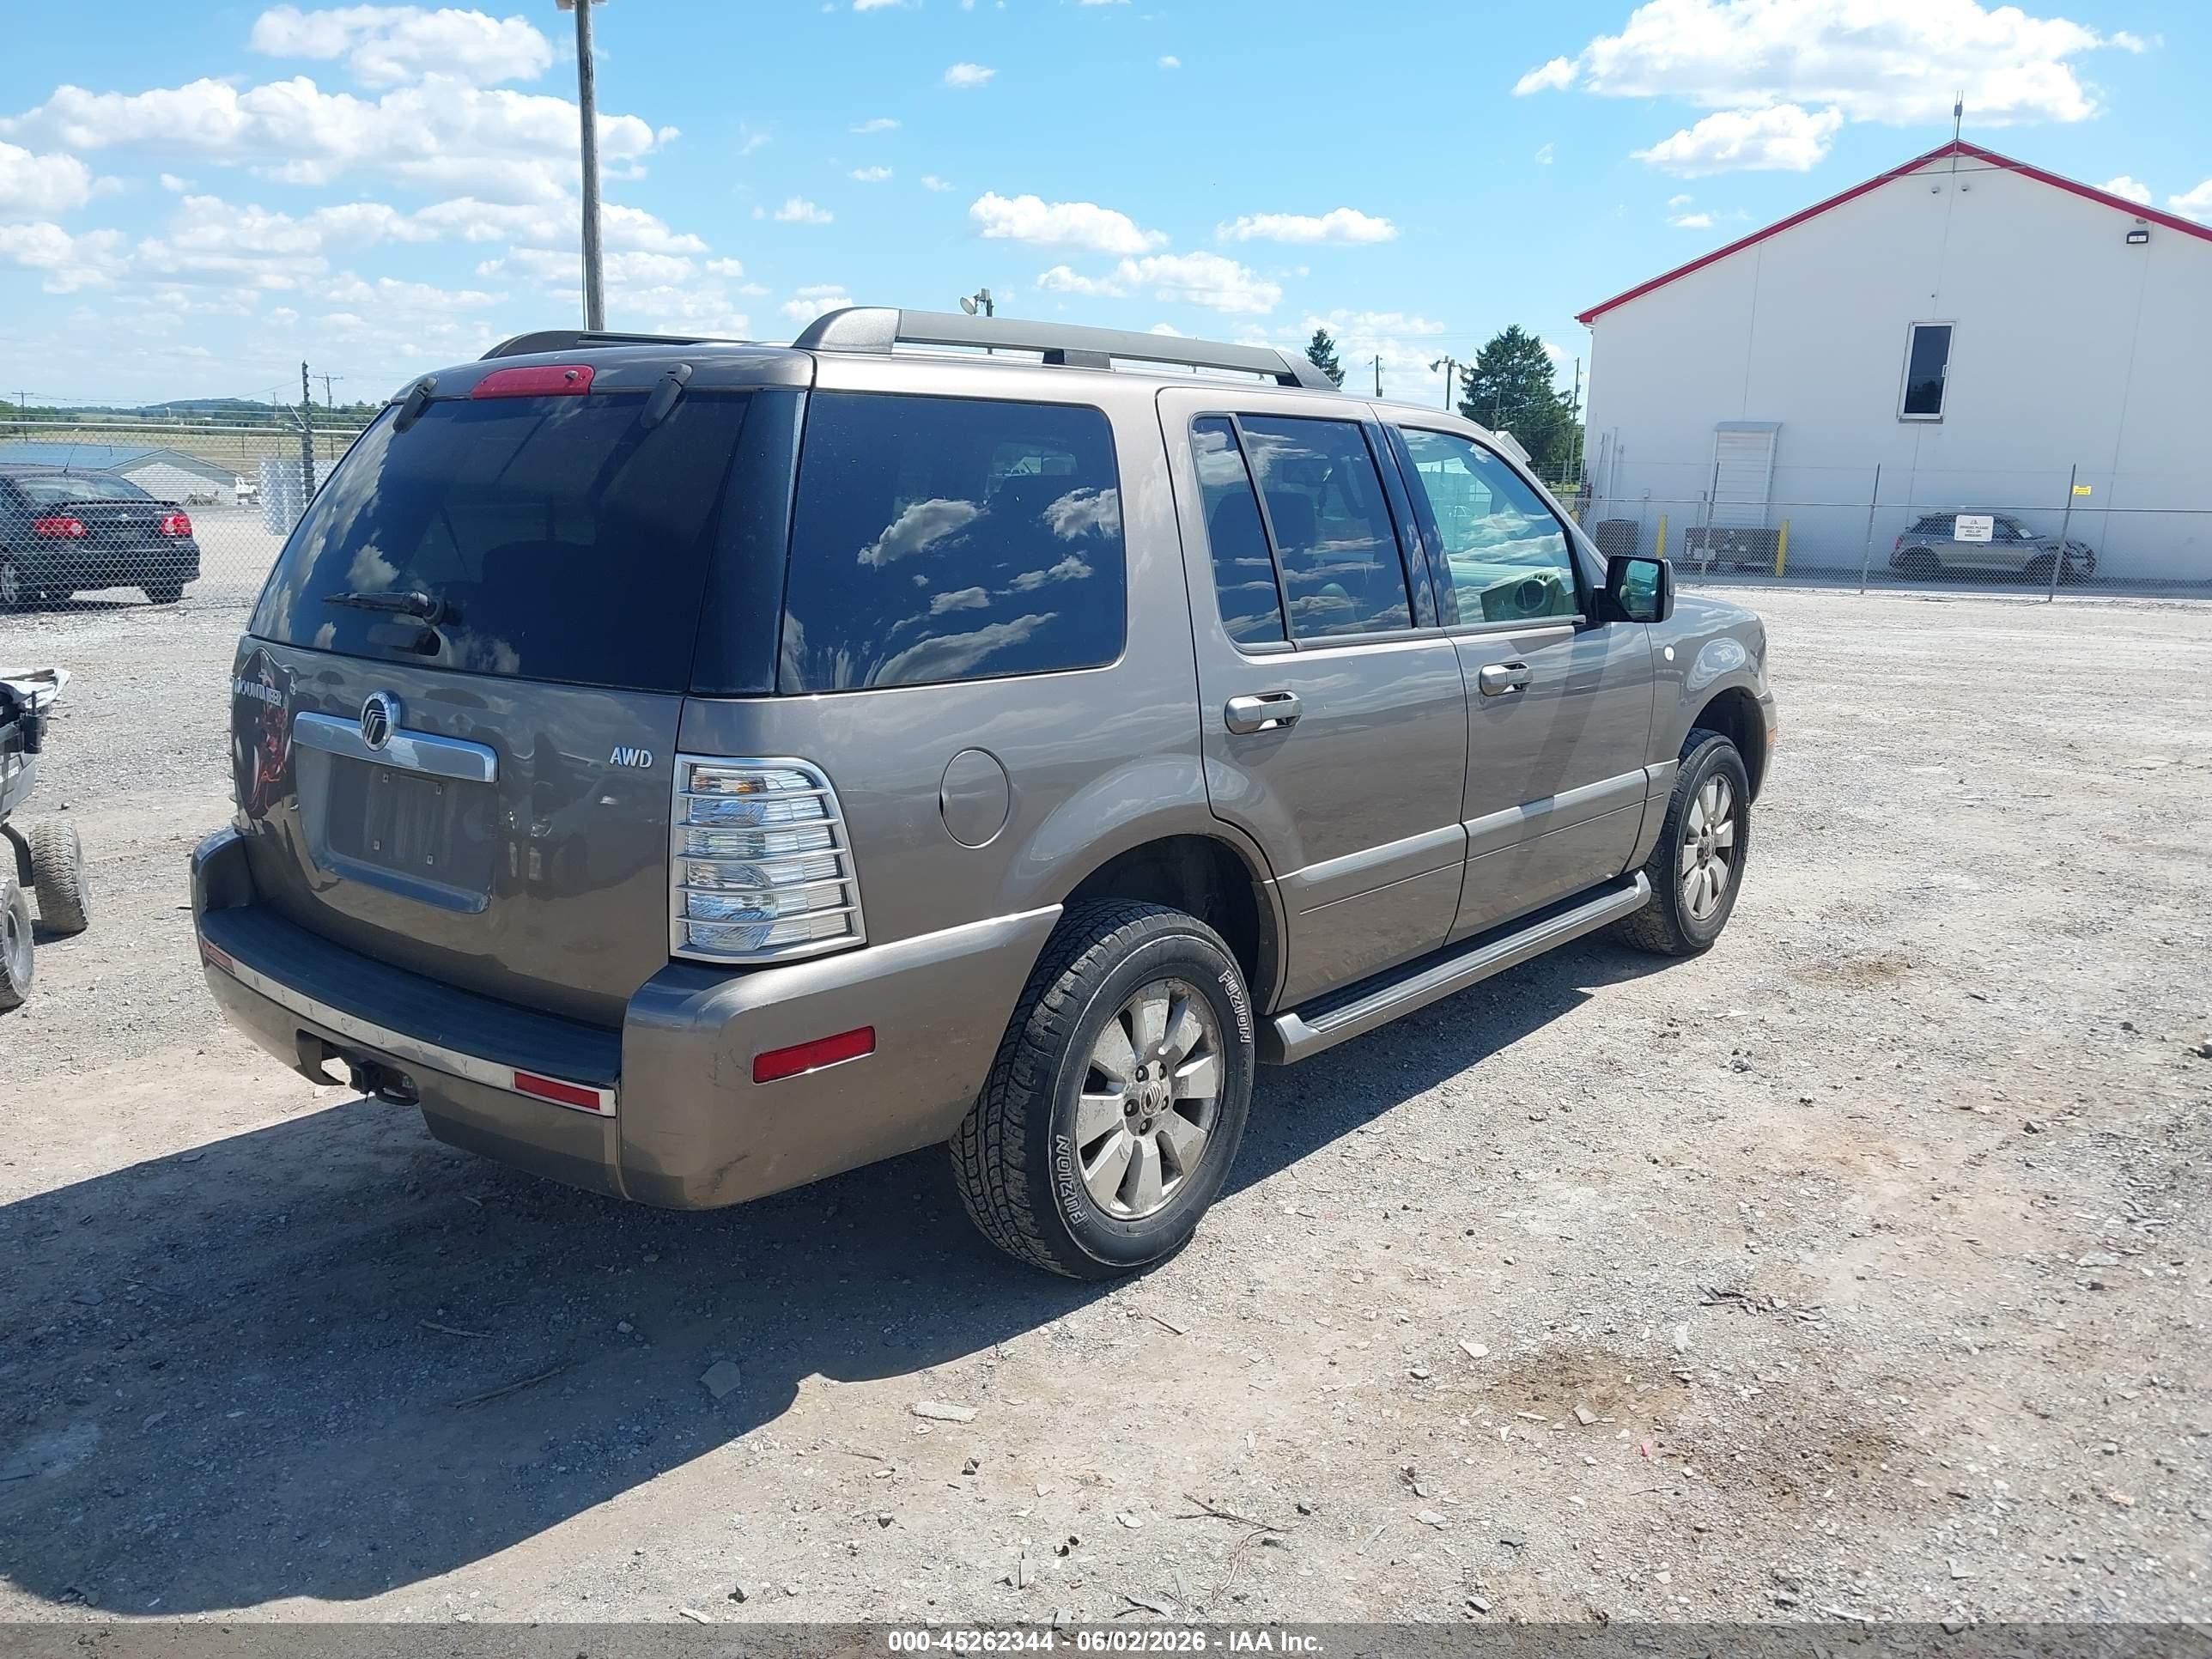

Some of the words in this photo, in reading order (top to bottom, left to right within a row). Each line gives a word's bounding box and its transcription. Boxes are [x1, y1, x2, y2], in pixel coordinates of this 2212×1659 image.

[609, 746, 653, 768] AWD
[1218, 969, 1252, 1044] FUZION
[1055, 1133, 1089, 1225] FUZION
